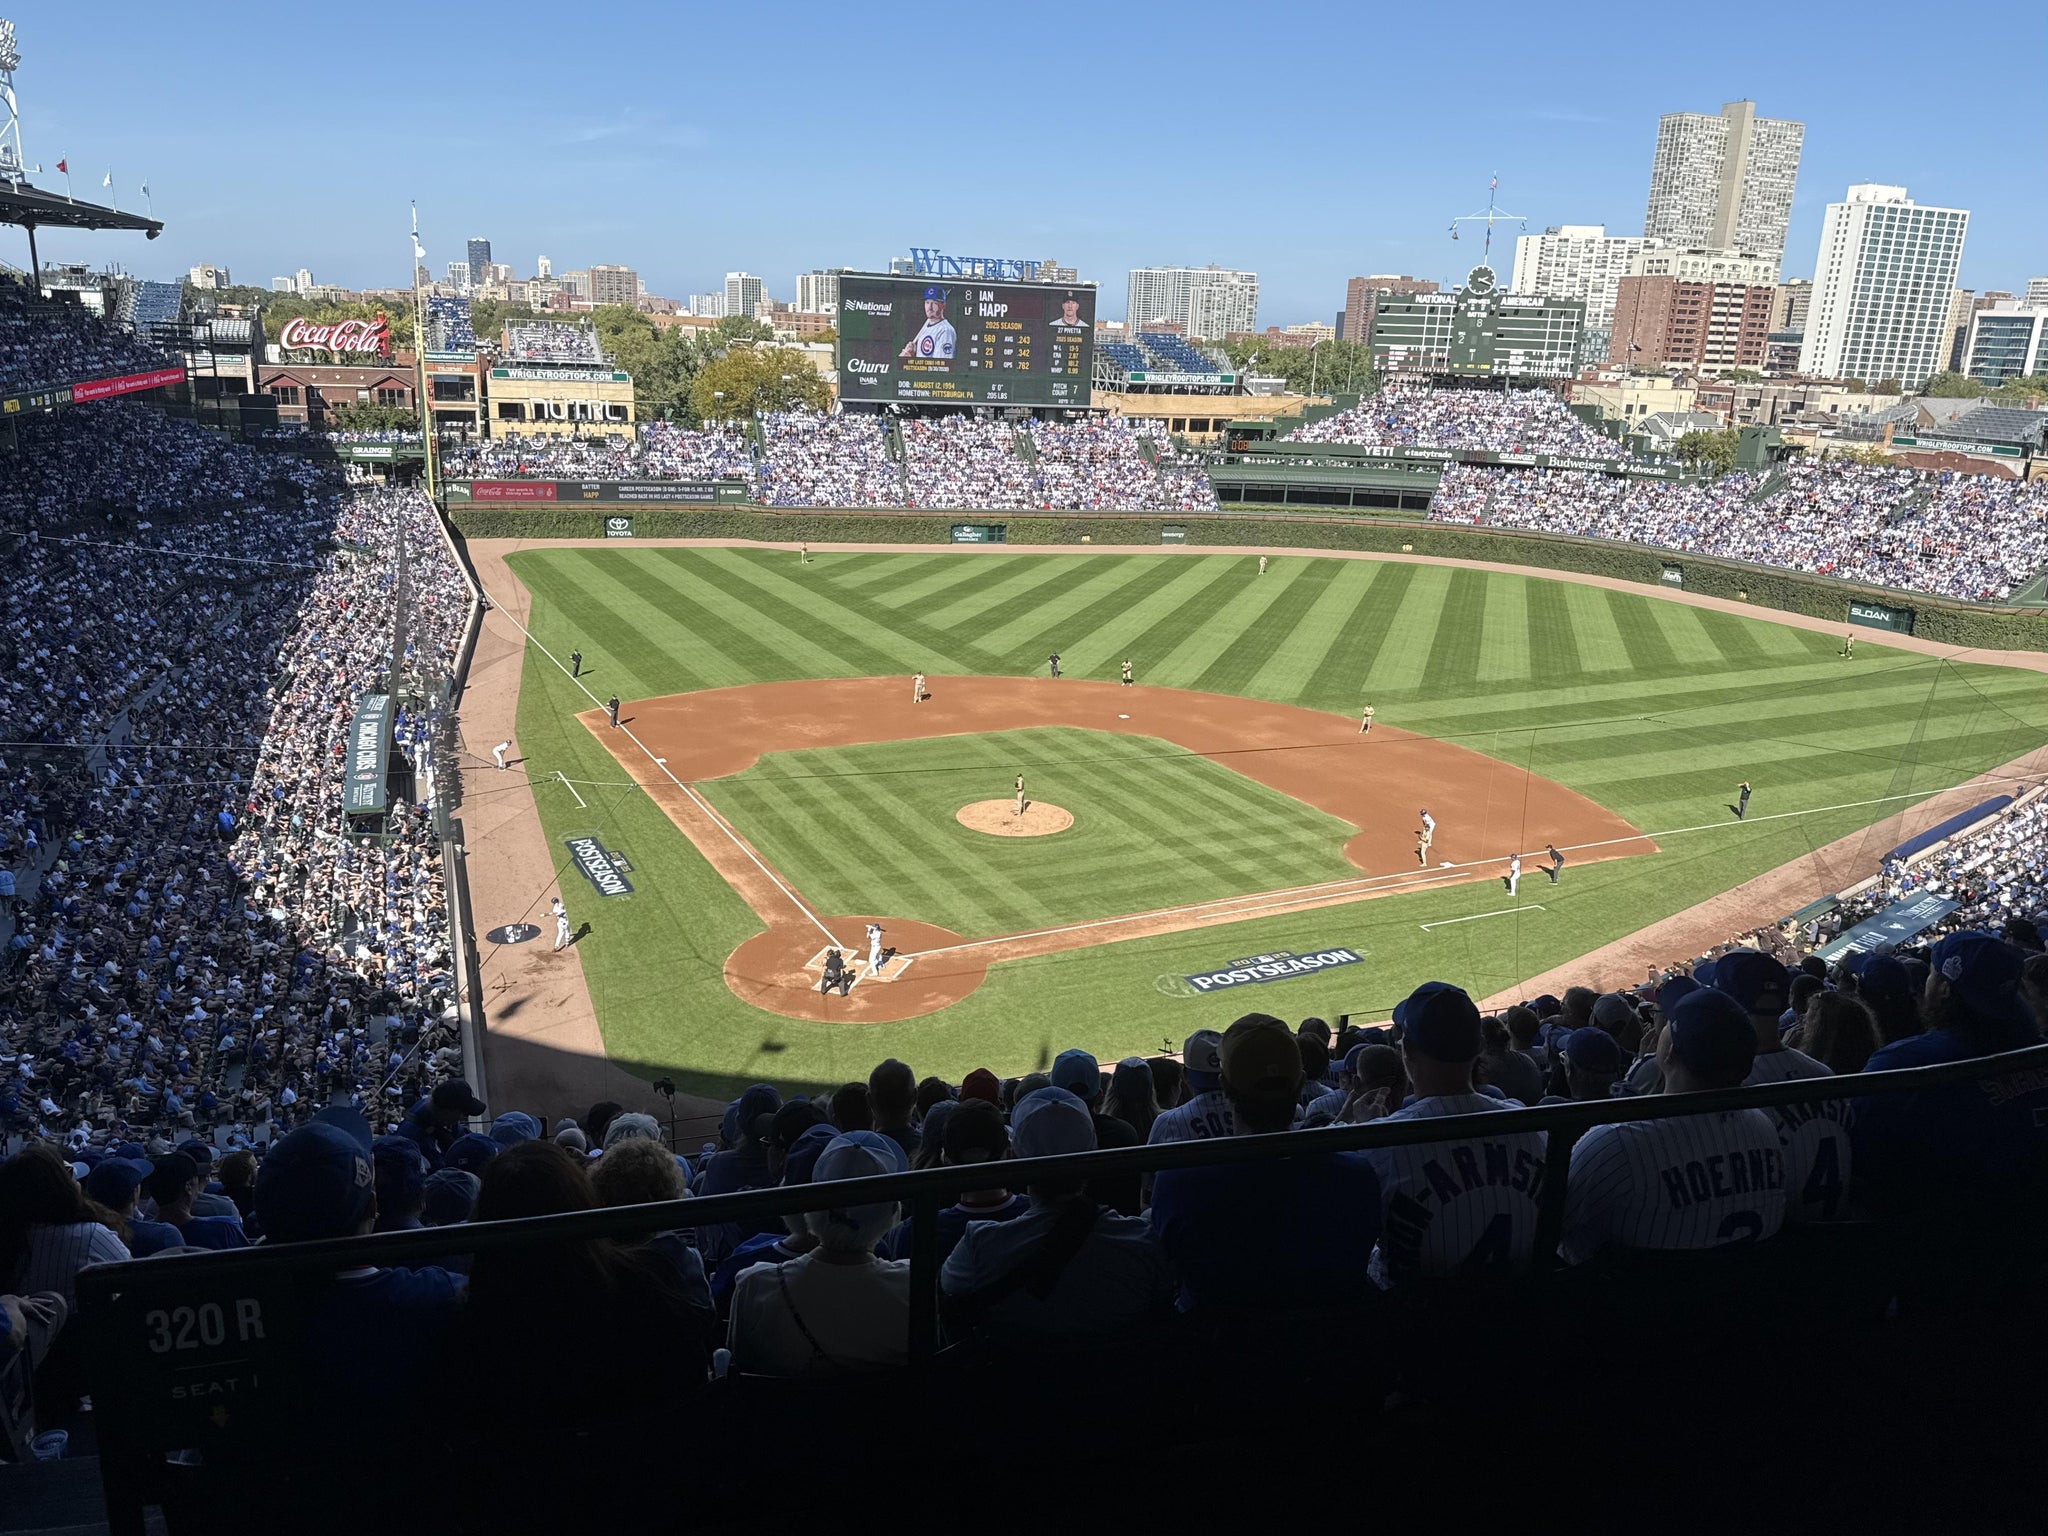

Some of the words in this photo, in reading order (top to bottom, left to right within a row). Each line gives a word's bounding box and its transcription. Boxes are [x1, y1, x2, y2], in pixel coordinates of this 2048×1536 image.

[910, 248, 1040, 280] WINTRUST
[965, 290, 972, 300] 8
[980, 290, 994, 302] IAN
[1415, 294, 1457, 304] NATIONAL
[856, 300, 892, 310] National
[1500, 296, 1544, 306] AMERICAN
[964, 306, 972, 316] LF
[979, 303, 1008, 317] HAPP
[1000, 322, 1022, 330] SEASON
[1476, 318, 1482, 328] 8
[281, 317, 383, 352] Coca-Cola
[1017, 336, 1030, 344] .243
[1458, 336, 1464, 344] 2
[1017, 349, 1030, 357] .342
[847, 358, 890, 374] Churu
[507, 370, 612, 380] WRIGLEYROOFTOPS.COM
[1145, 374, 1220, 382] WRIGLEYROOFTOPS.COM
[1074, 385, 1078, 394] 7
[1364, 446, 1394, 456] YETI
[1916, 440, 1993, 453] WRIGLEYROOFTOPS.COM
[1410, 450, 1452, 459] tastytrade
[1499, 453, 1536, 461] GRAINGER
[1628, 464, 1666, 475] Advocate
[452, 484, 470, 496] BEAM
[476, 487, 502, 496] Coca-Cola
[1664, 572, 1681, 581] Hefty
[1851, 607, 1889, 621] SLOAN
[357, 722, 379, 750] CHICAGO
[356, 750, 378, 770] CUBS
[571, 839, 628, 895] POSTSEASON
[1233, 958, 1250, 967] 20
[1272, 951, 1290, 959] 25
[1192, 949, 1356, 990] POSTSEASON
[1802, 1136, 1843, 1217] 4
[146, 1302, 226, 1353] 320
[235, 1298, 266, 1342] R
[172, 1378, 240, 1400] SEAT
